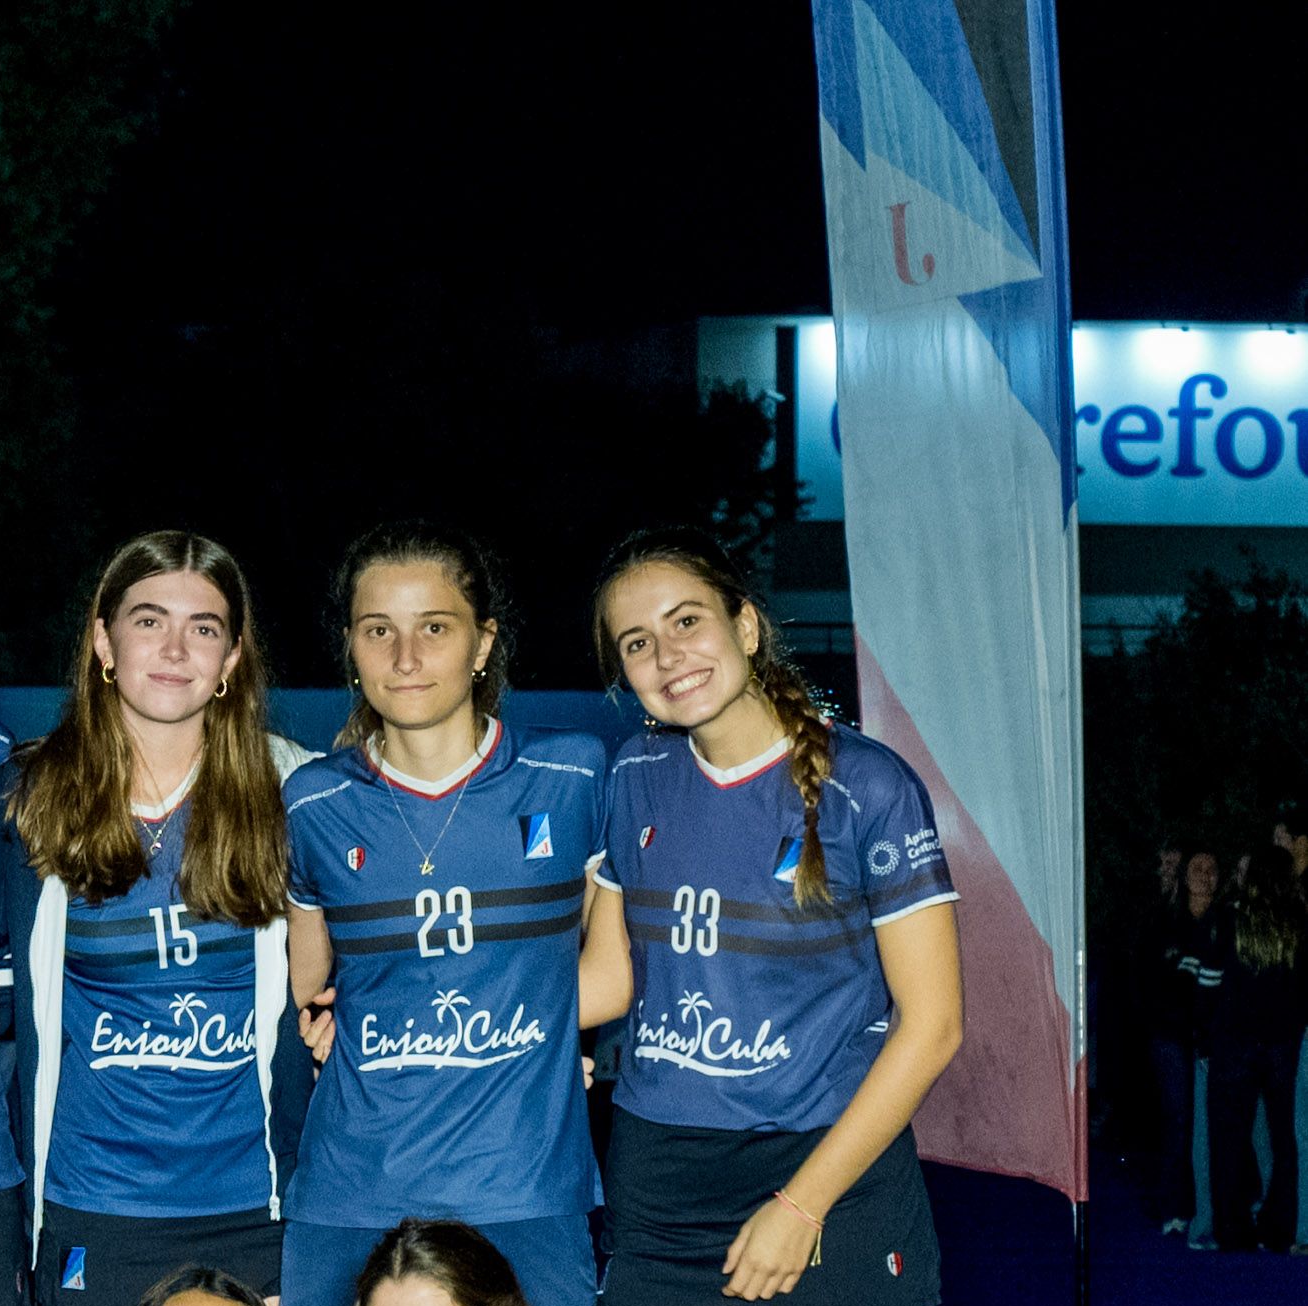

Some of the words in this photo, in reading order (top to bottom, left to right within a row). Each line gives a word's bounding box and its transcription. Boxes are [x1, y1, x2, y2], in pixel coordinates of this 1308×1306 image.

[517, 756, 595, 778] PORSCHE
[149, 903, 198, 970] 15
[415, 885, 474, 958] 23
[671, 885, 720, 957] 33
[90, 1012, 198, 1058] Enjoy
[361, 1013, 463, 1058] Enjoy
[464, 1004, 546, 1050] Cuba
[637, 1000, 702, 1060] njoy
[703, 1017, 791, 1061] Cuba
